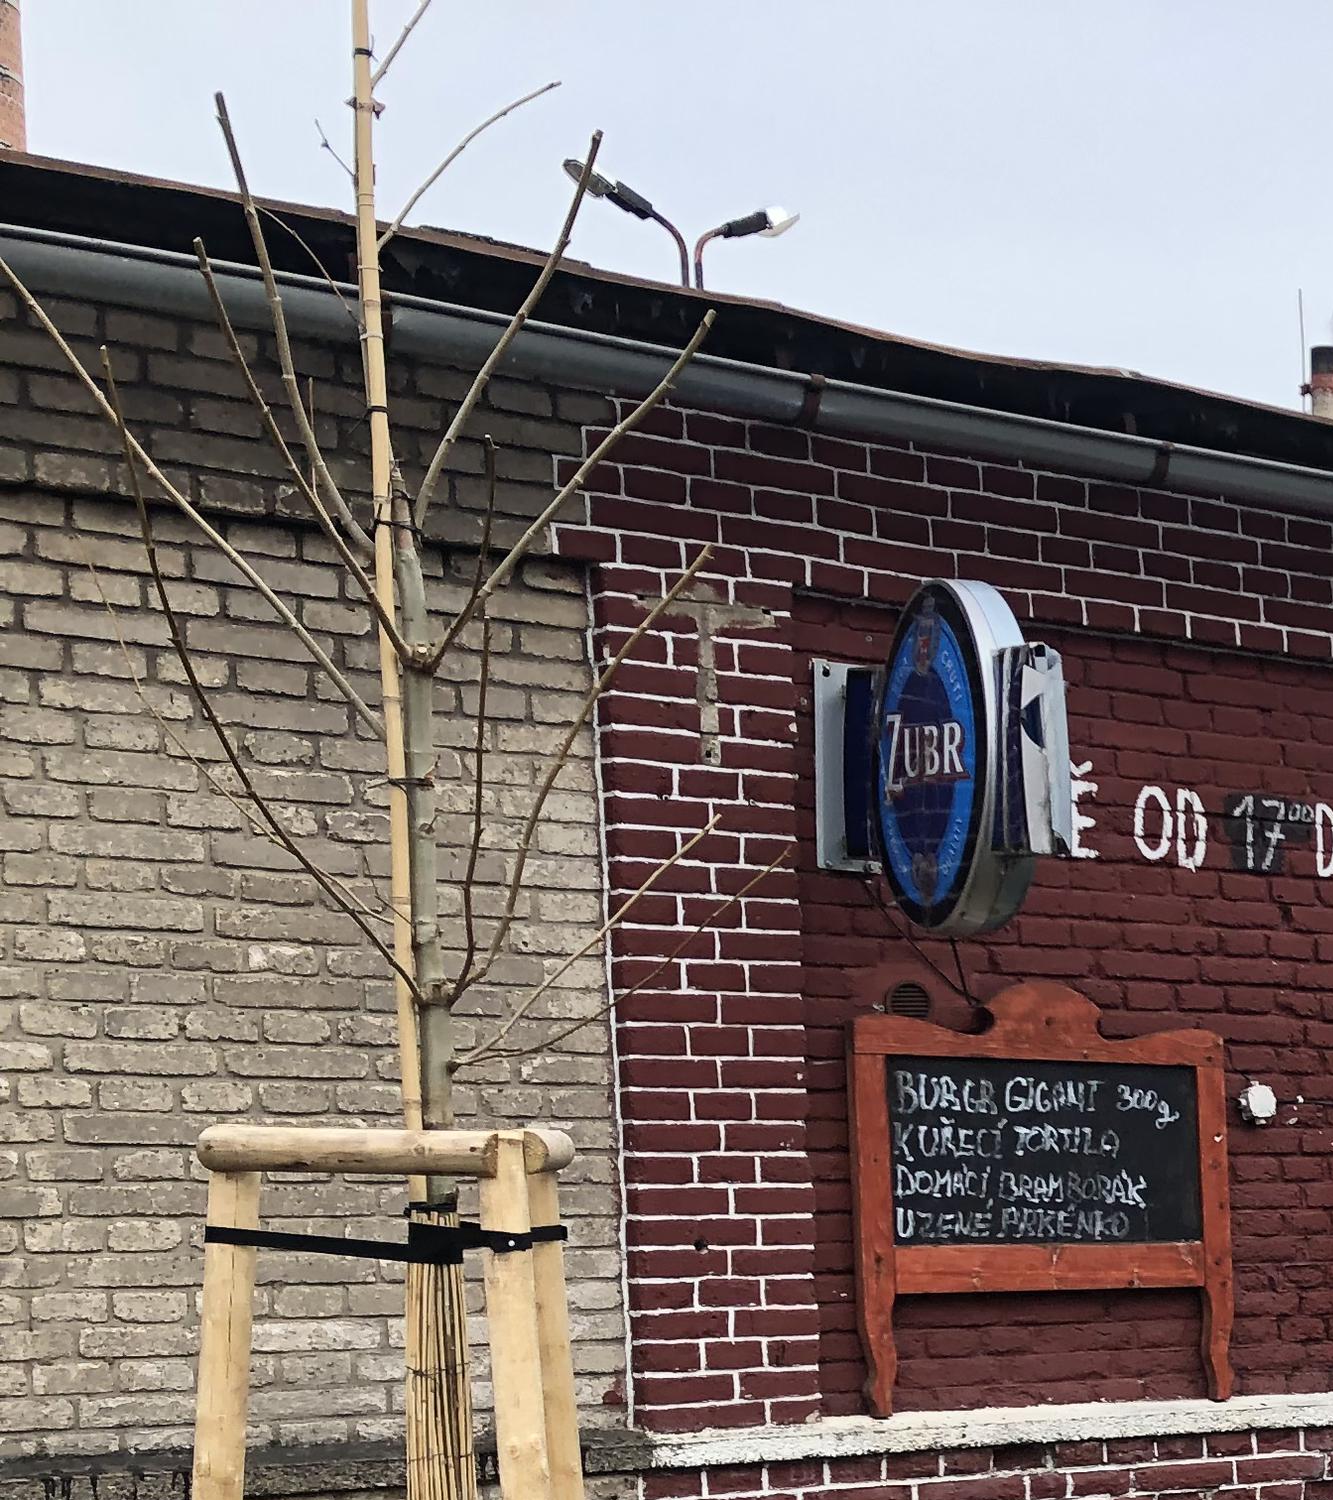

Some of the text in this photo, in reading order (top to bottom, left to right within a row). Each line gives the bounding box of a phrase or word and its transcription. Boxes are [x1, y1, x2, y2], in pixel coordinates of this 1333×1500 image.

[885, 714, 964, 804] ZUBR
[1134, 785, 1208, 872] OD
[892, 1116, 1008, 1162] KUŘECÍ
[895, 1163, 1148, 1209] DOMÁCÍ BRAMBORÁK
[895, 1198, 994, 1239] UZENÉ
